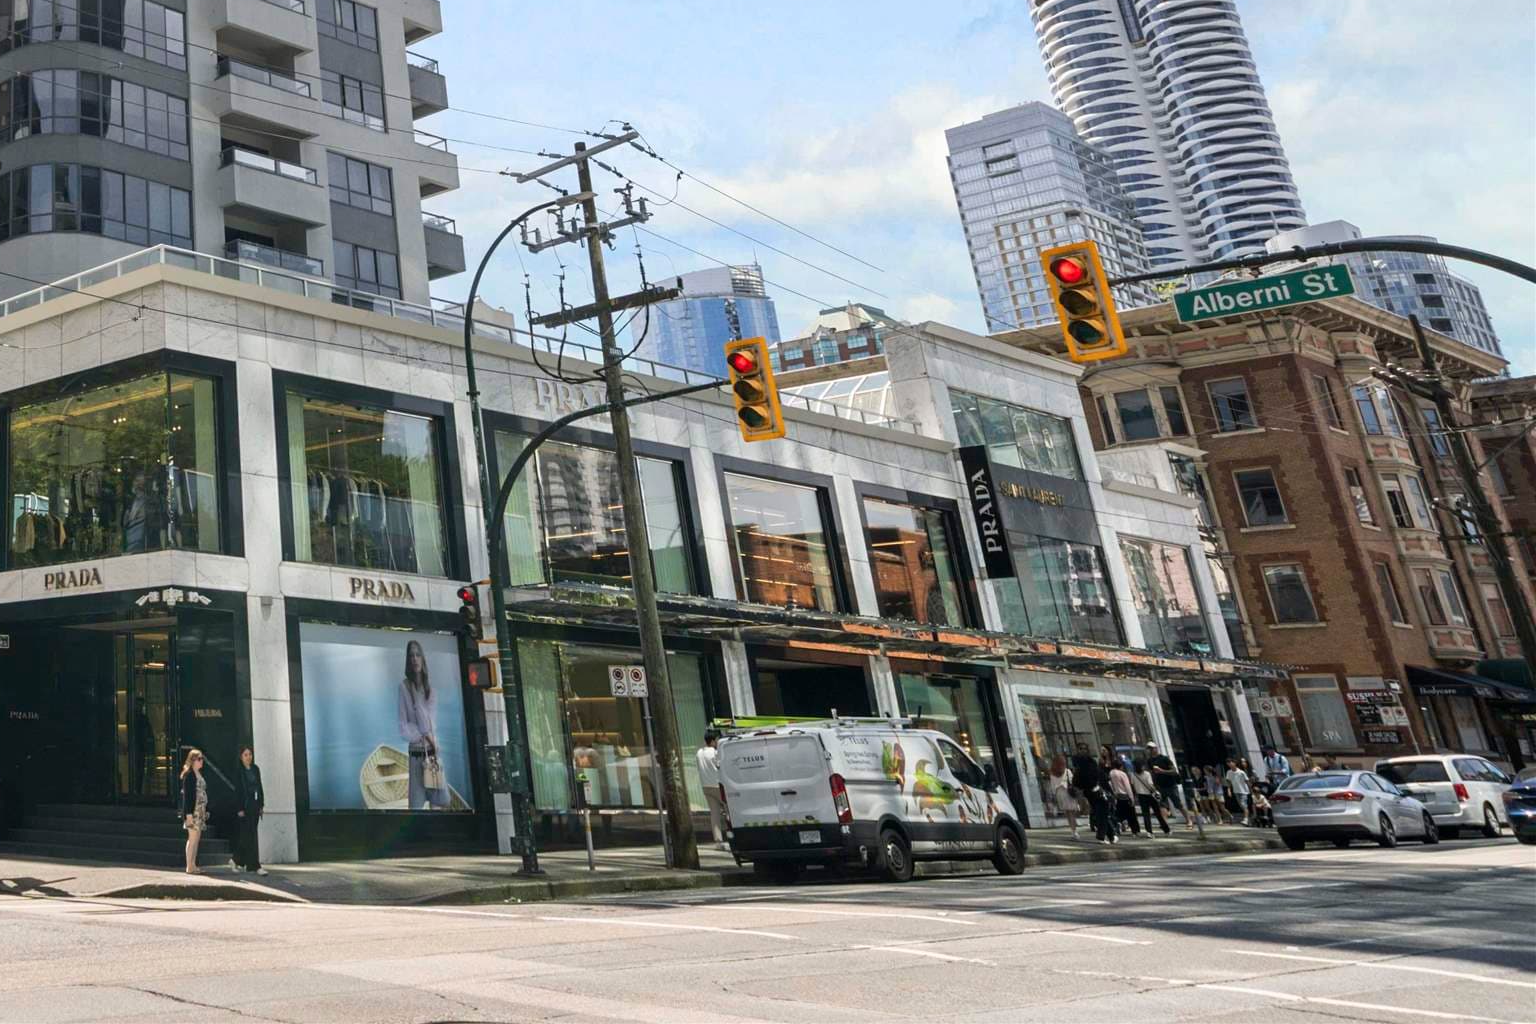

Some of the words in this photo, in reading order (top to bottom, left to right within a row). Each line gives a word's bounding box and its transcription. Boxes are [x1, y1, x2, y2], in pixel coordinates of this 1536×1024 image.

[1192, 279, 1291, 316] Alberni
[1301, 273, 1339, 296] St
[971, 468, 1004, 553] PRADA
[44, 567, 103, 591] PRADA
[349, 576, 415, 601] PRADA
[1322, 730, 1342, 741] SPA
